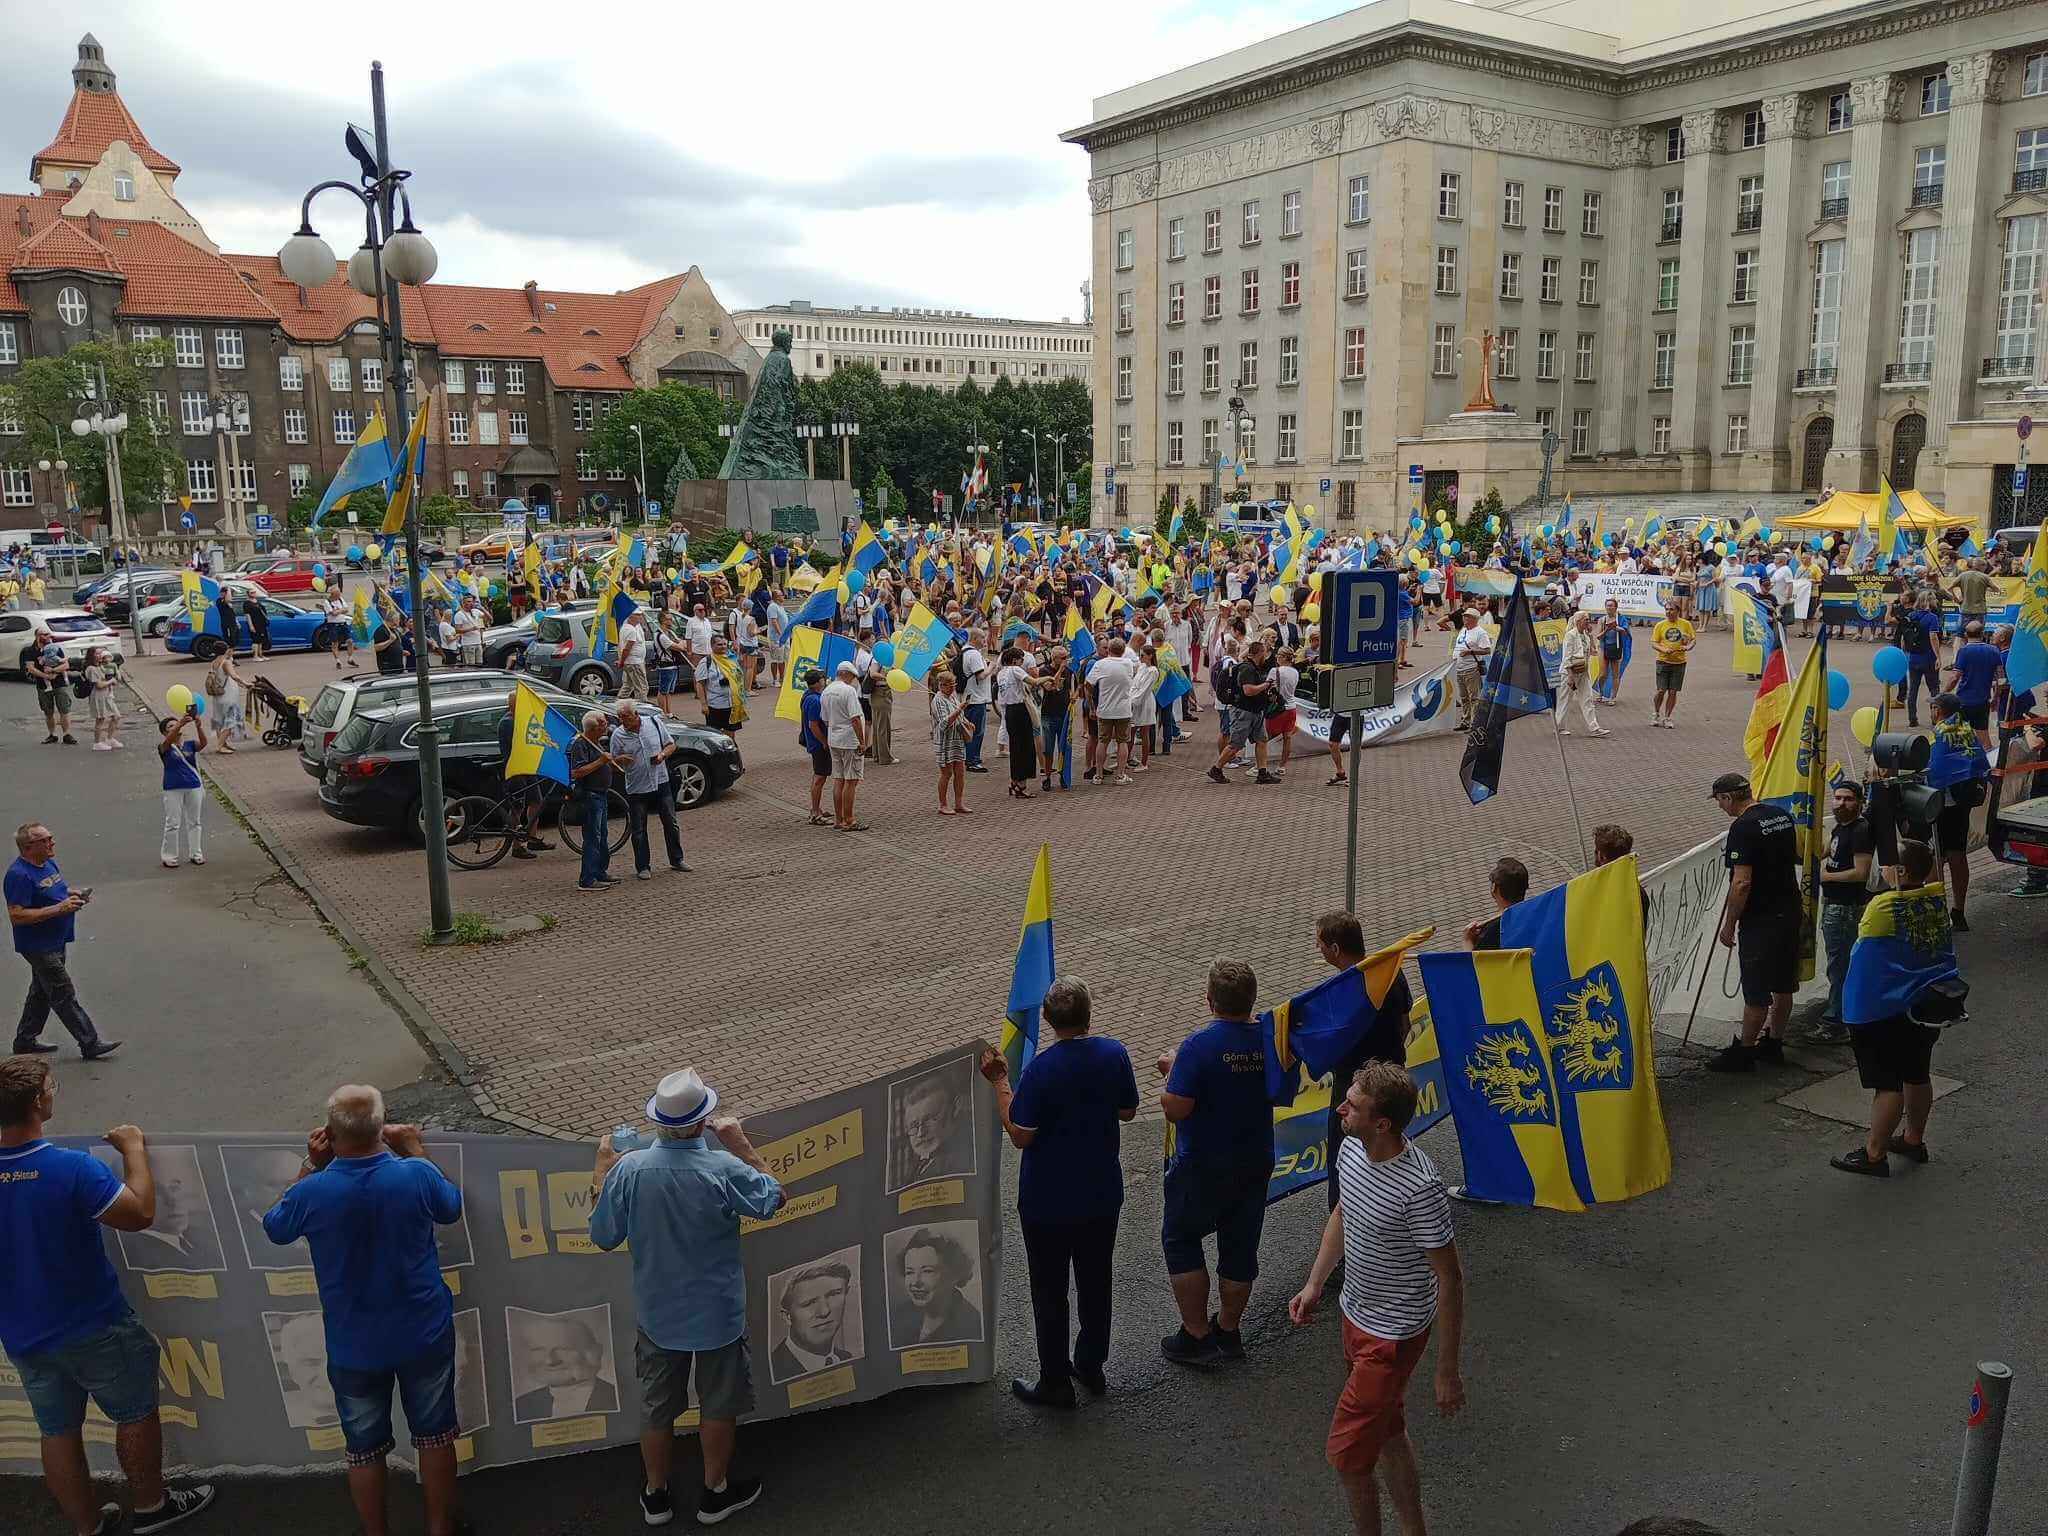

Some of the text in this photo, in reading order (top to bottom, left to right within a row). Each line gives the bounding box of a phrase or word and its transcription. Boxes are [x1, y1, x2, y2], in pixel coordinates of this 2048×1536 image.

[1601, 578, 1620, 586] NASZ
[1630, 588, 1648, 597] DOM
[1347, 581, 1385, 653] P
[1362, 640, 1395, 654] Płatny
